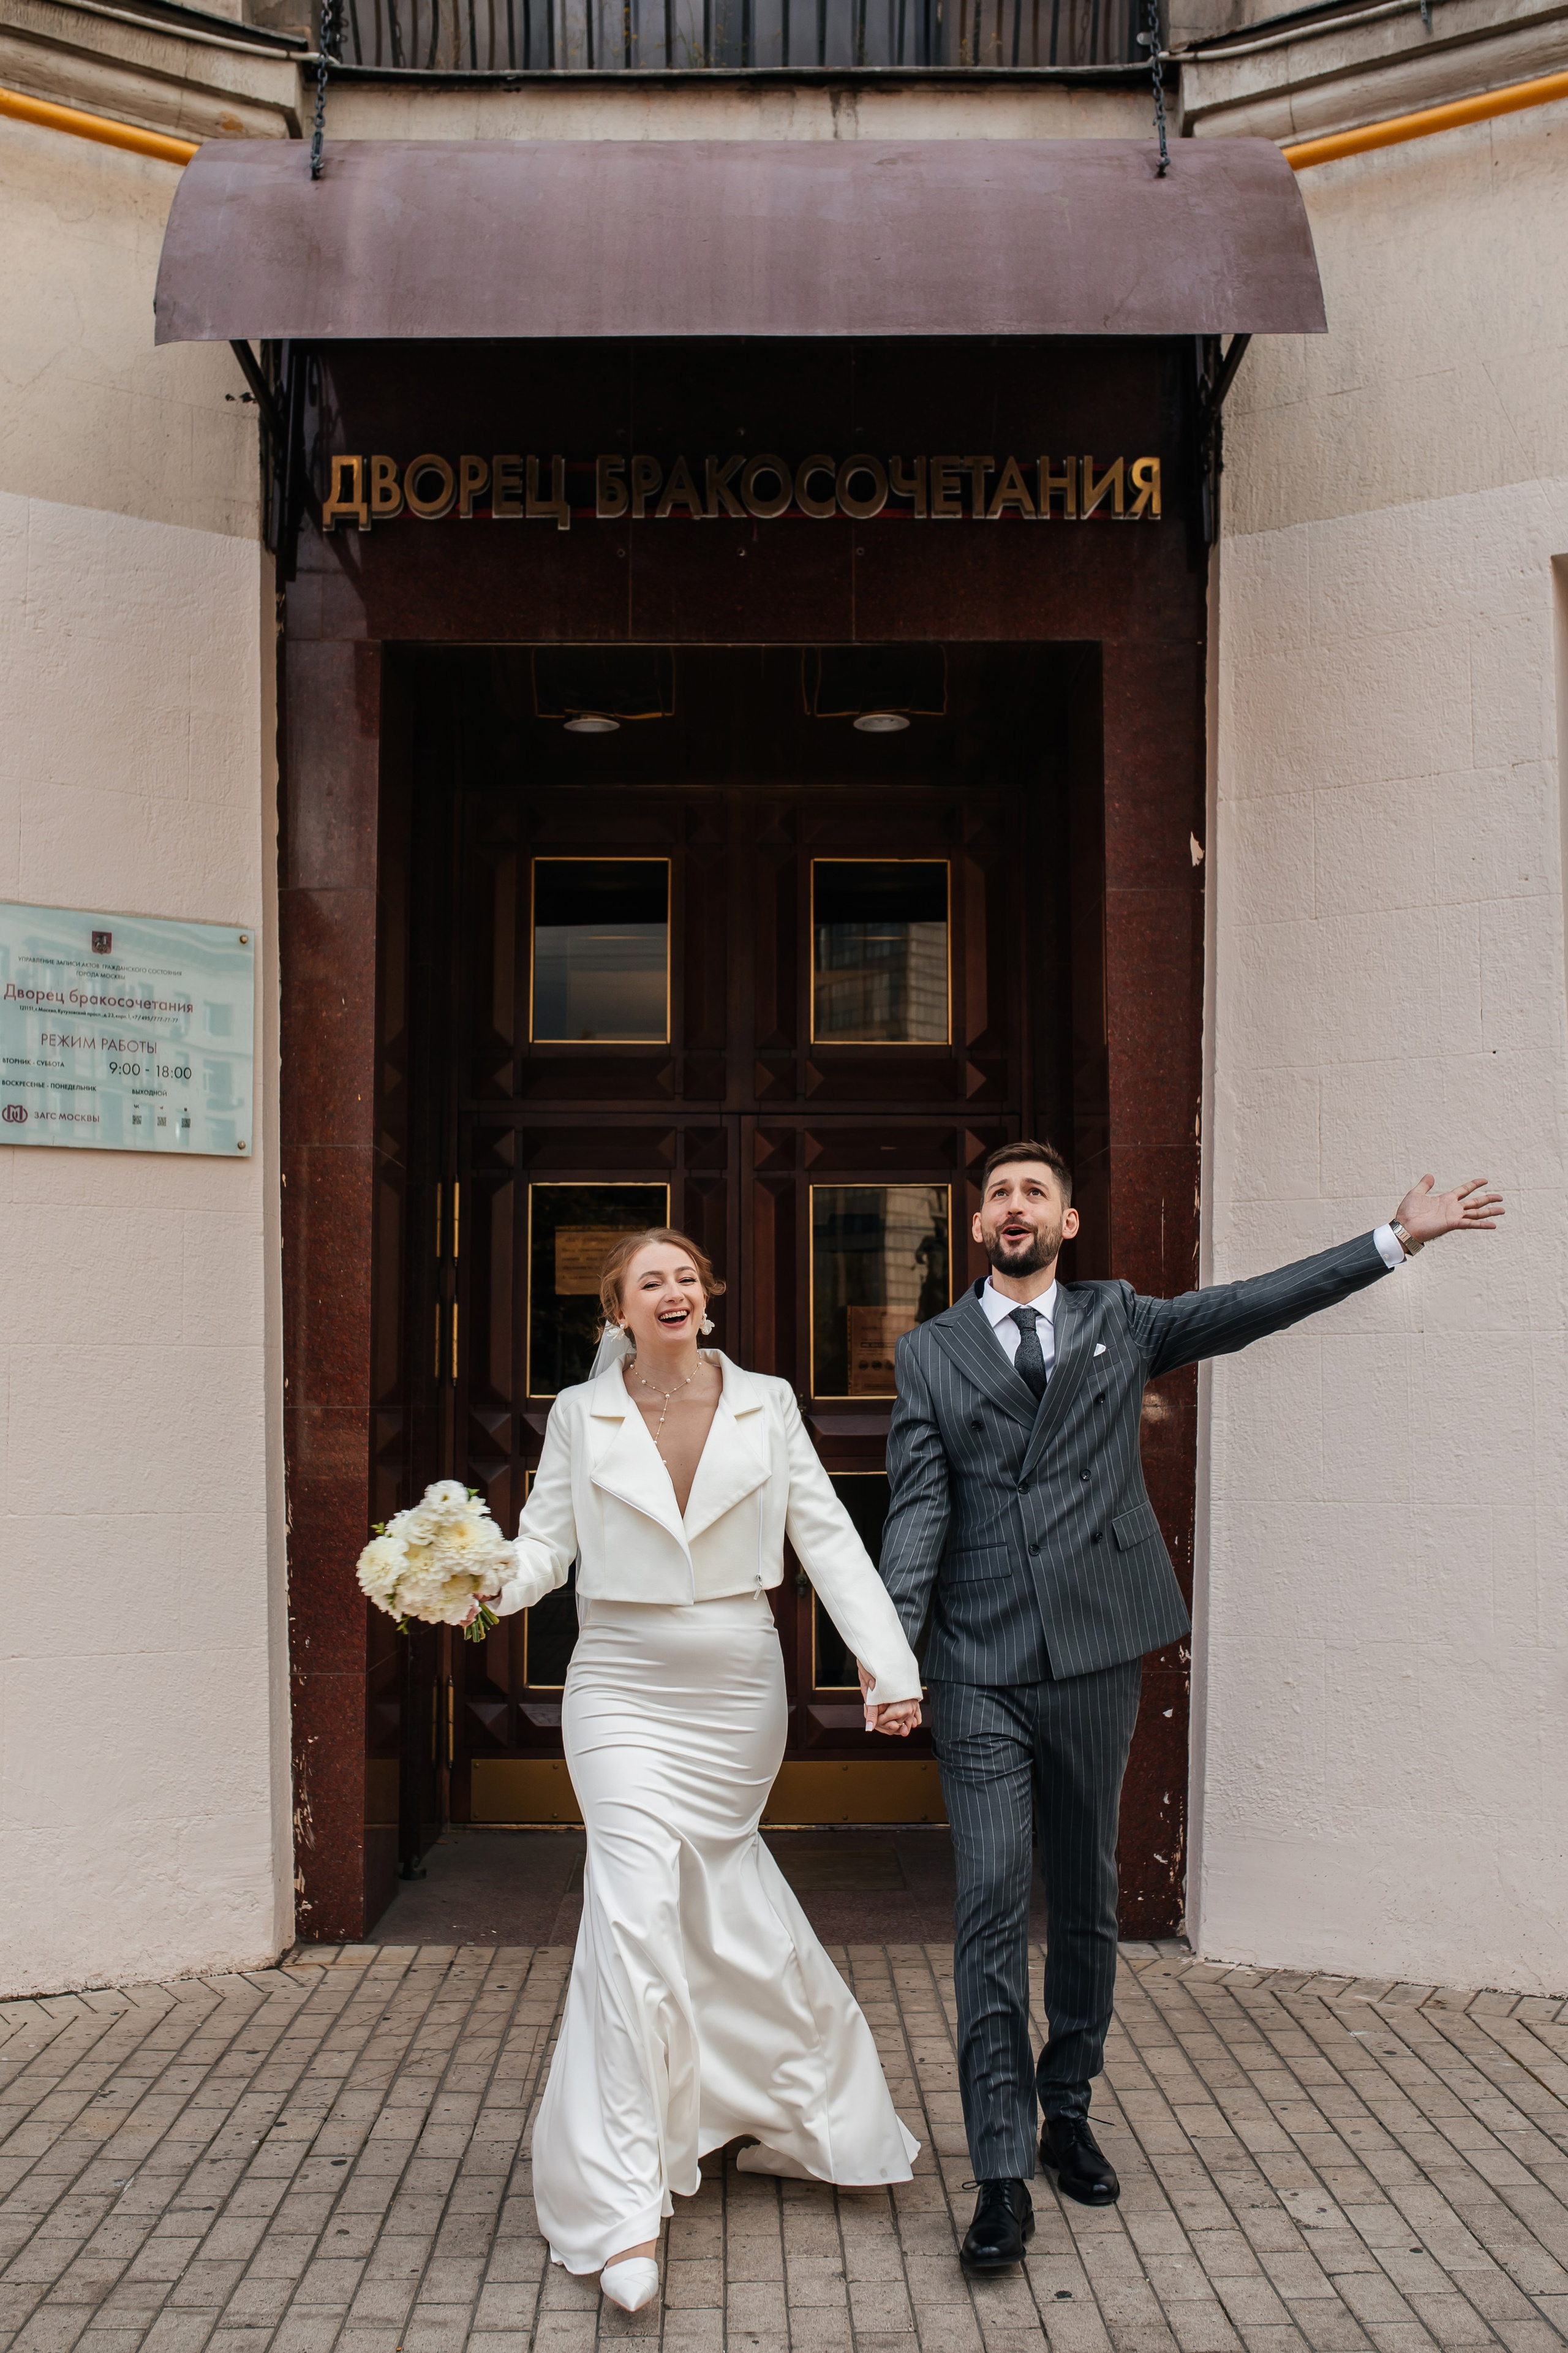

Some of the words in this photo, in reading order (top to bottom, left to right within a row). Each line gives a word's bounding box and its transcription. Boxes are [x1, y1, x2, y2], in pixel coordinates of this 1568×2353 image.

[323, 453, 570, 531] ДВОРЕЦ
[595, 453, 1162, 519] БРАКОСОЧЕТАНИЯ
[18, 956, 55, 965] УПРАВЛЕНИЕ
[102, 964, 147, 973] ГРАЖДАНСКОГО
[4, 984, 64, 1004] Дворец
[69, 989, 194, 1013] бракосочетания
[41, 1033, 96, 1049] РЕЖИМ
[102, 1038, 157, 1054] РАБОТЫ
[109, 1062, 141, 1076] 9:00
[156, 1065, 192, 1079] 18:00
[2, 1079, 45, 1089] ВОСКРЕСЕНЬЕ
[50, 1082, 97, 1092] ПОНЕДЕЛЬНИК
[132, 1088, 168, 1097] ВЫХОДНОЙ
[34, 1111, 57, 1120] ЗАГС
[59, 1112, 100, 1123] МОСКВЫ
